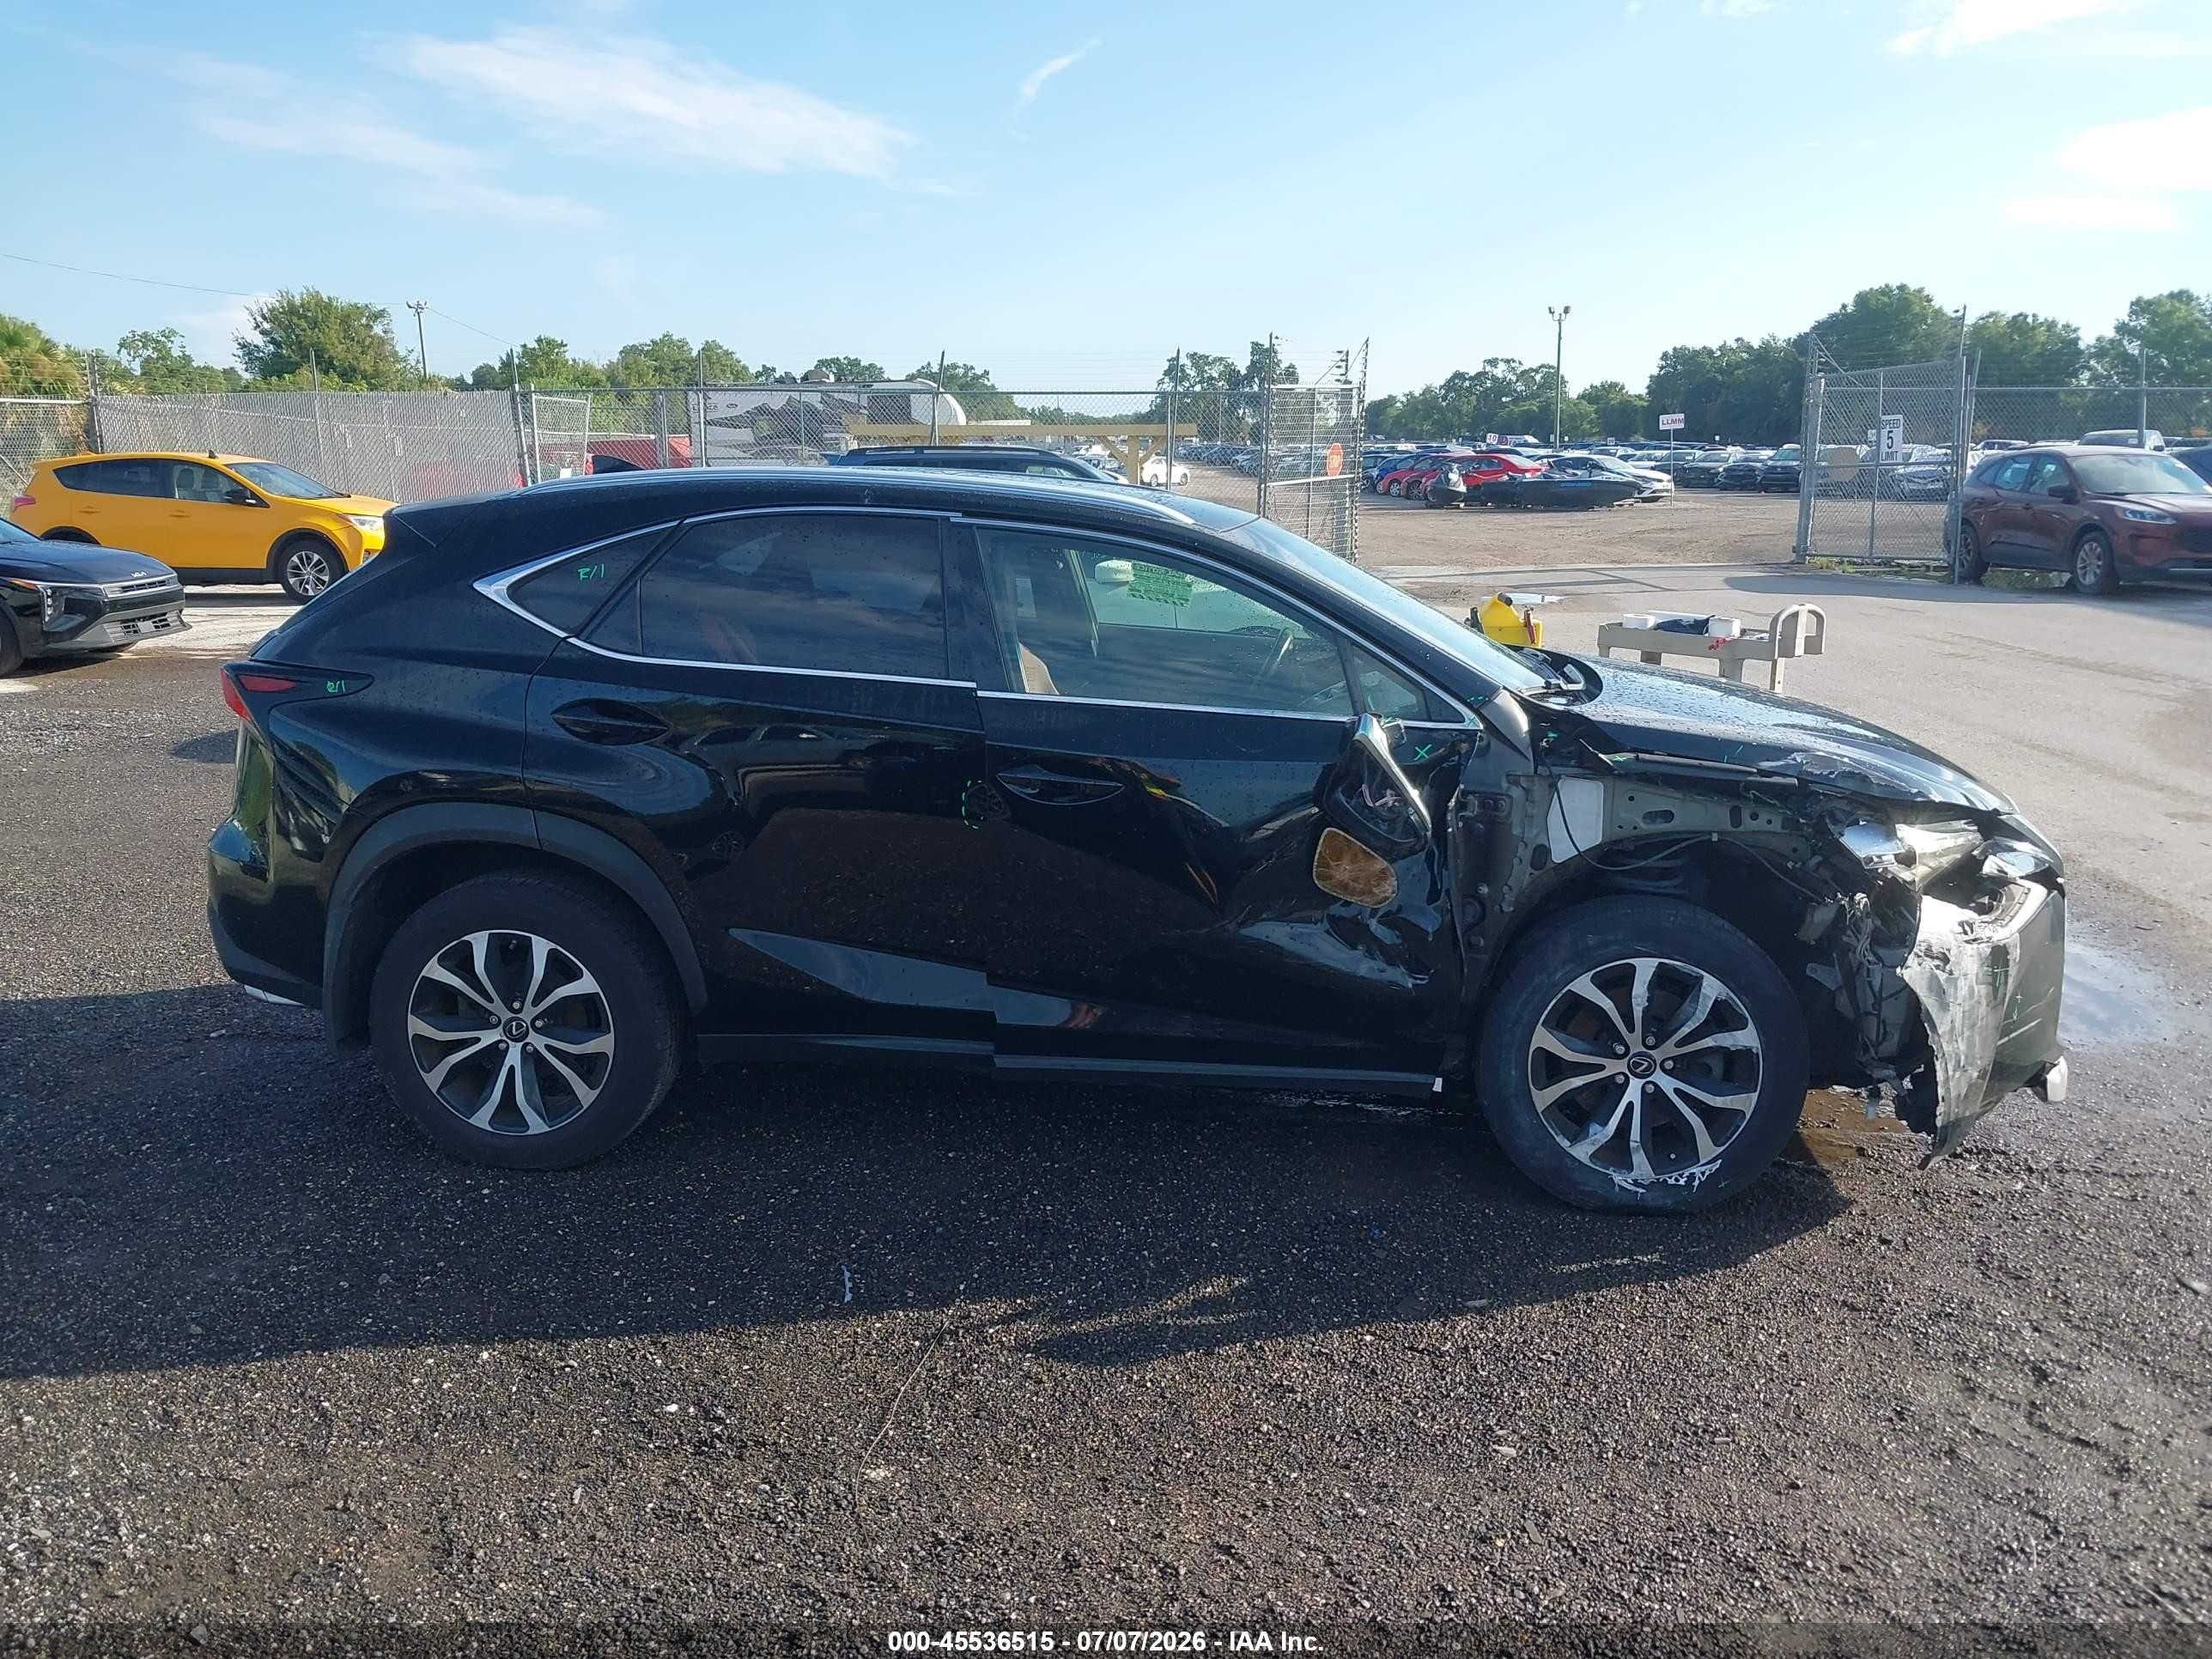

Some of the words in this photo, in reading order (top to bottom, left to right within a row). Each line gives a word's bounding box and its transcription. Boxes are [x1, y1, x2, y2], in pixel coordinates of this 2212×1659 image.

[1881, 418, 1901, 429] SPEED
[1487, 434, 1498, 442] 10
[1887, 429, 1894, 449] 5
[1328, 454, 1340, 468] STOP
[1881, 451, 1898, 461] LIMIT
